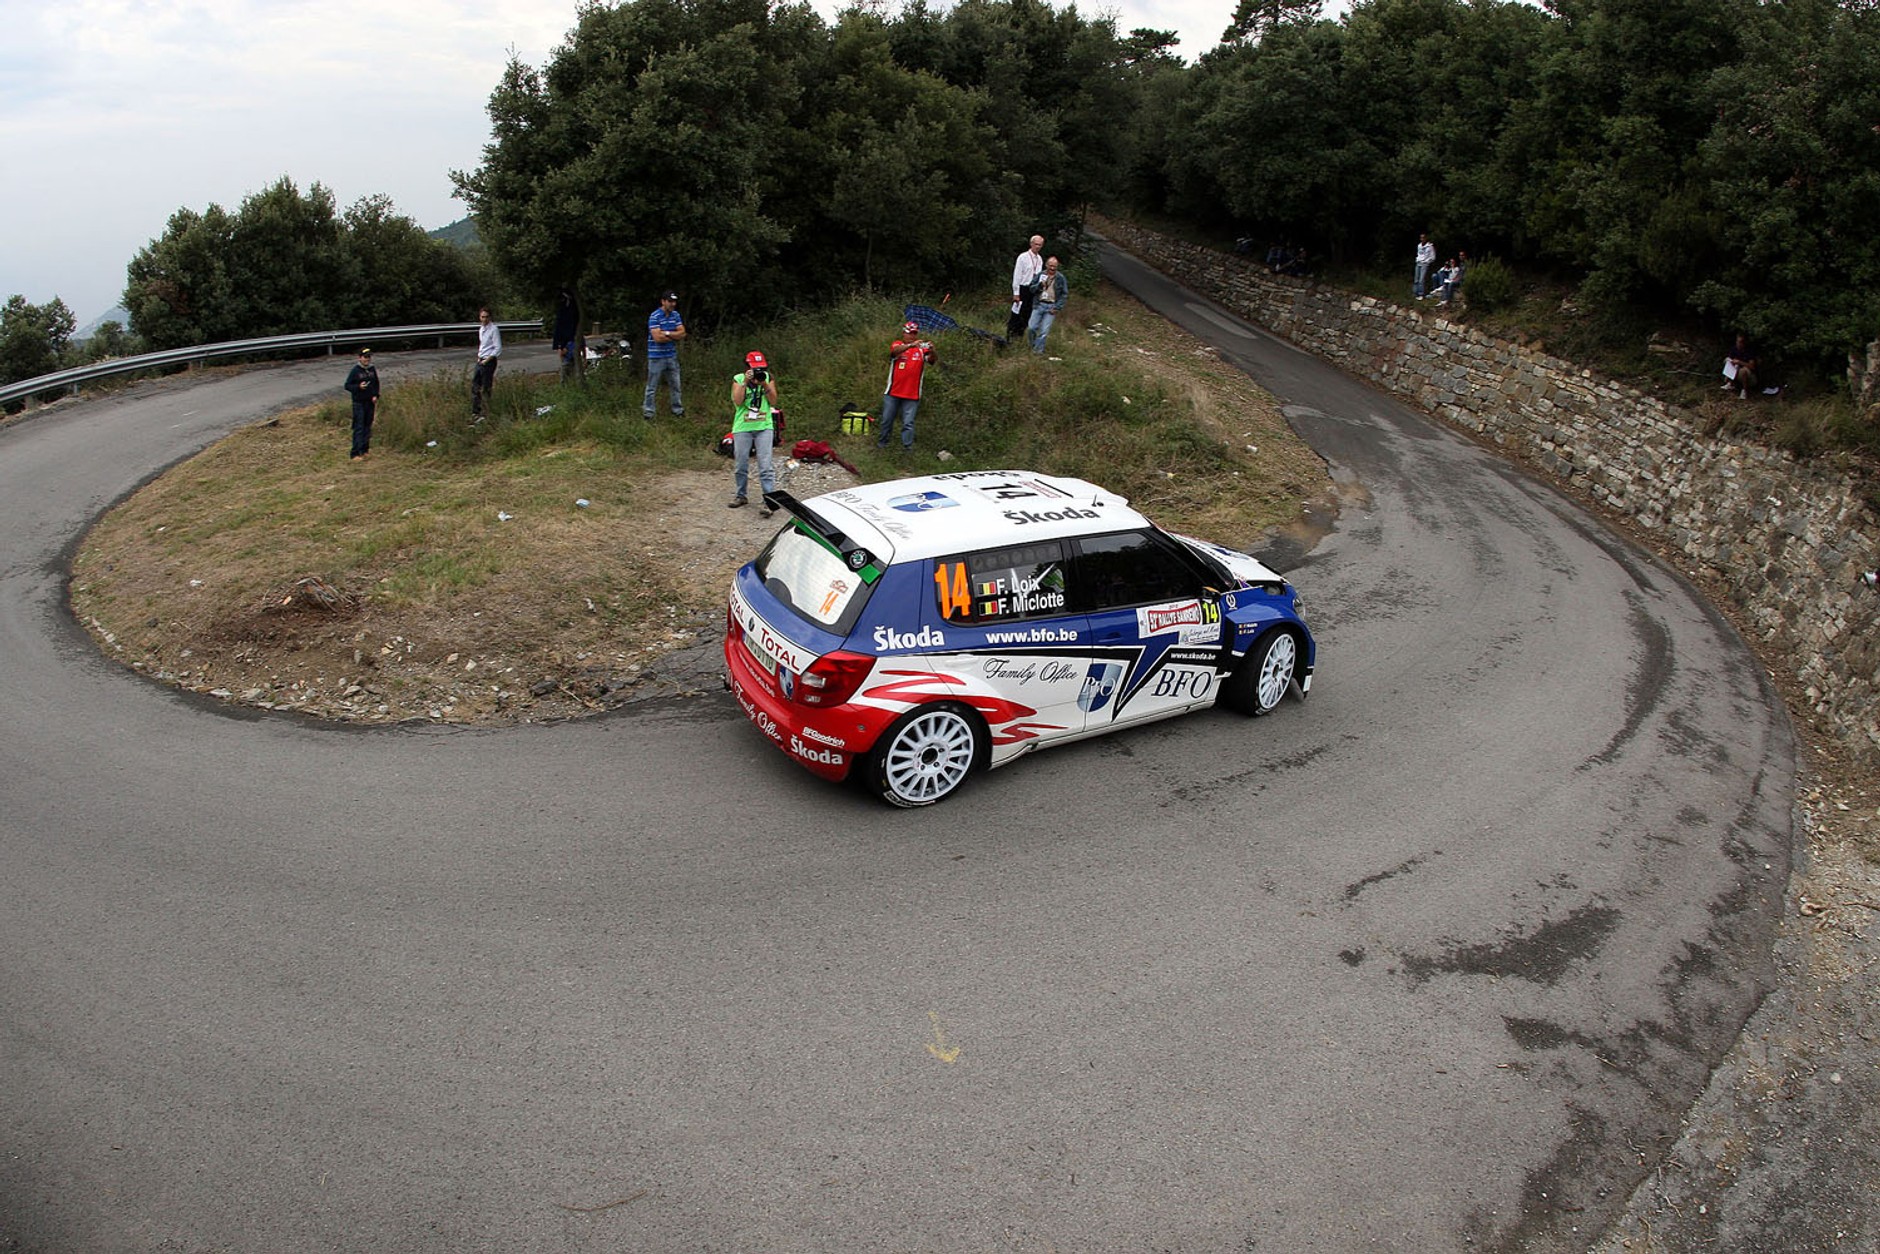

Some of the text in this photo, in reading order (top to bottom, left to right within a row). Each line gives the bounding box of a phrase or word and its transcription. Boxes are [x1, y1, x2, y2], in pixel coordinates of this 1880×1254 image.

[980, 483, 1038, 499] 14
[1003, 507, 1101, 525] Škoda
[934, 561, 971, 619] 14
[996, 574, 1041, 595] F. Loix
[819, 590, 838, 615] 14
[998, 592, 1065, 615] F. Miclotte
[1203, 602, 1218, 623] 14
[873, 624, 945, 652] Škoda
[985, 628, 1078, 644] www.bfo.be
[761, 627, 800, 672] TOTAL
[983, 657, 1078, 685] Family Office
[1151, 668, 1214, 699] BFO
[757, 711, 783, 742] Office
[790, 734, 844, 765] Škoda
